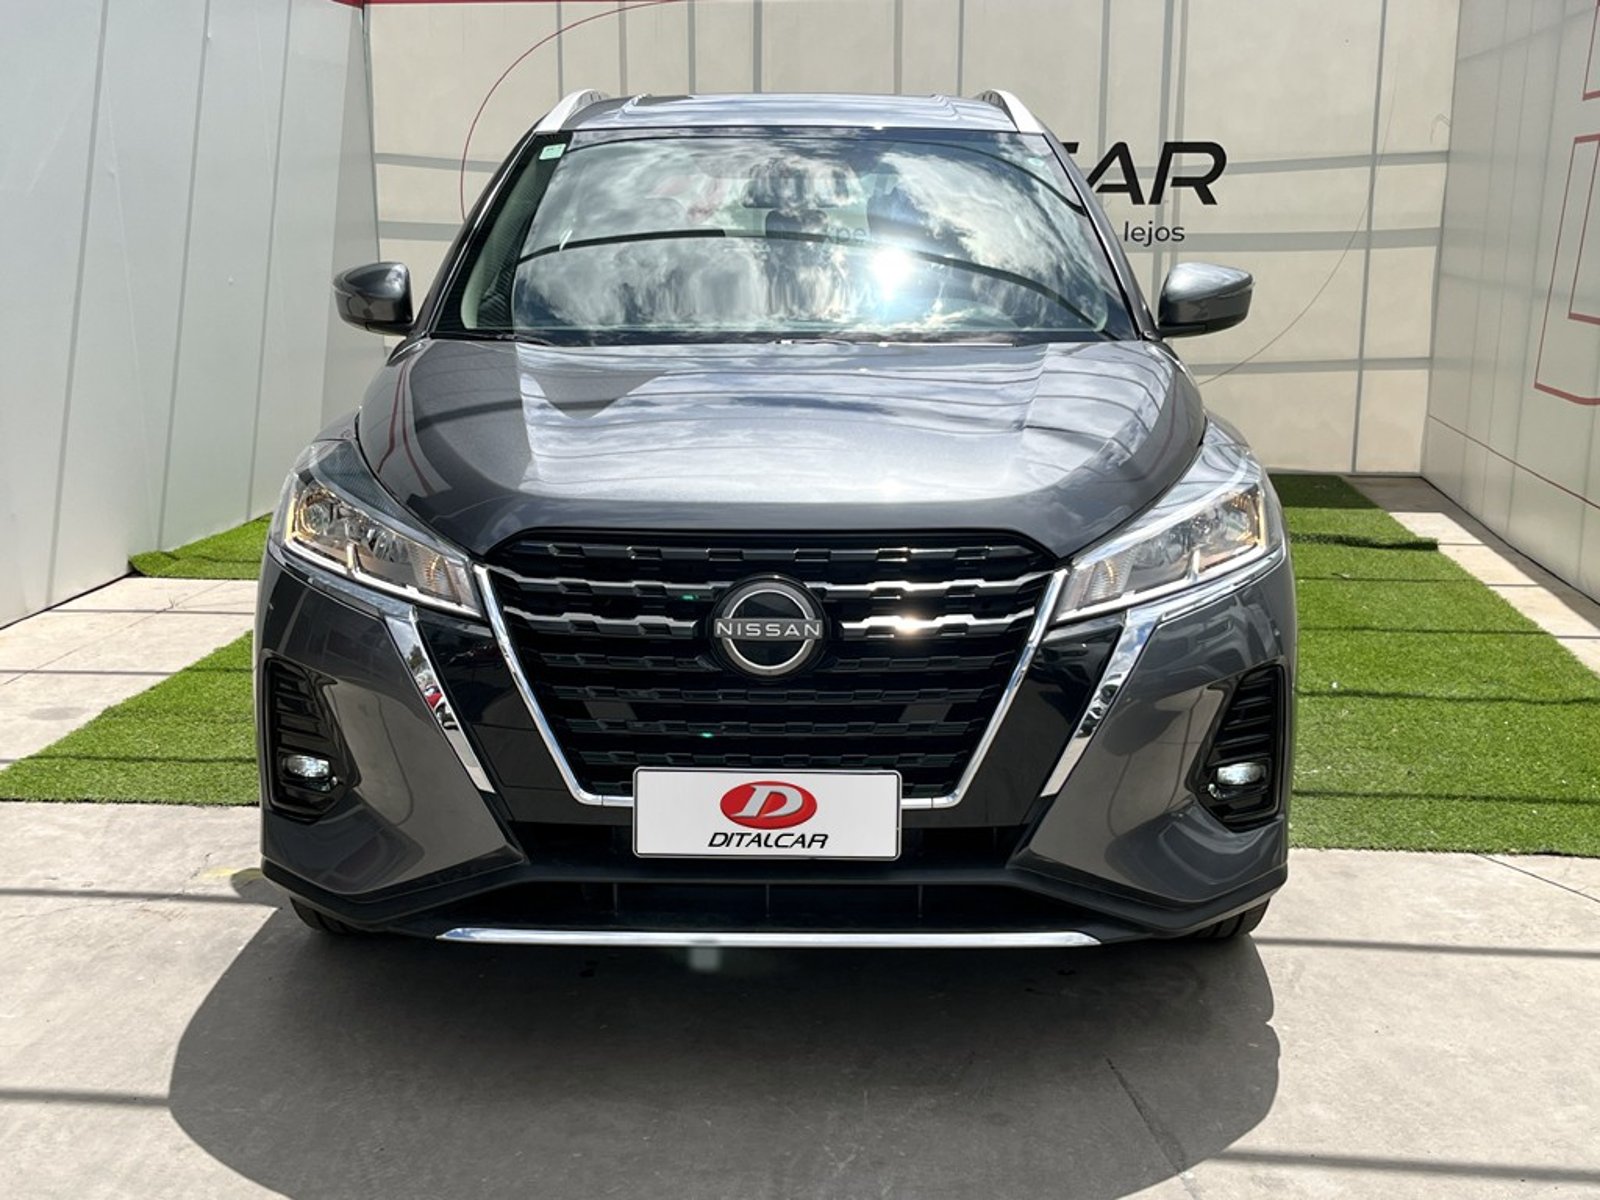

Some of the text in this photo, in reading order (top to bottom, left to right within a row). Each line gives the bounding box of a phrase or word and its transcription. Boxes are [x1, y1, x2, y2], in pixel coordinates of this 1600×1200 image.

[1061, 141, 1227, 205] AR
[1123, 221, 1186, 247] lejos
[716, 622, 821, 637] NISSAN
[708, 832, 829, 849] DITALCAR
